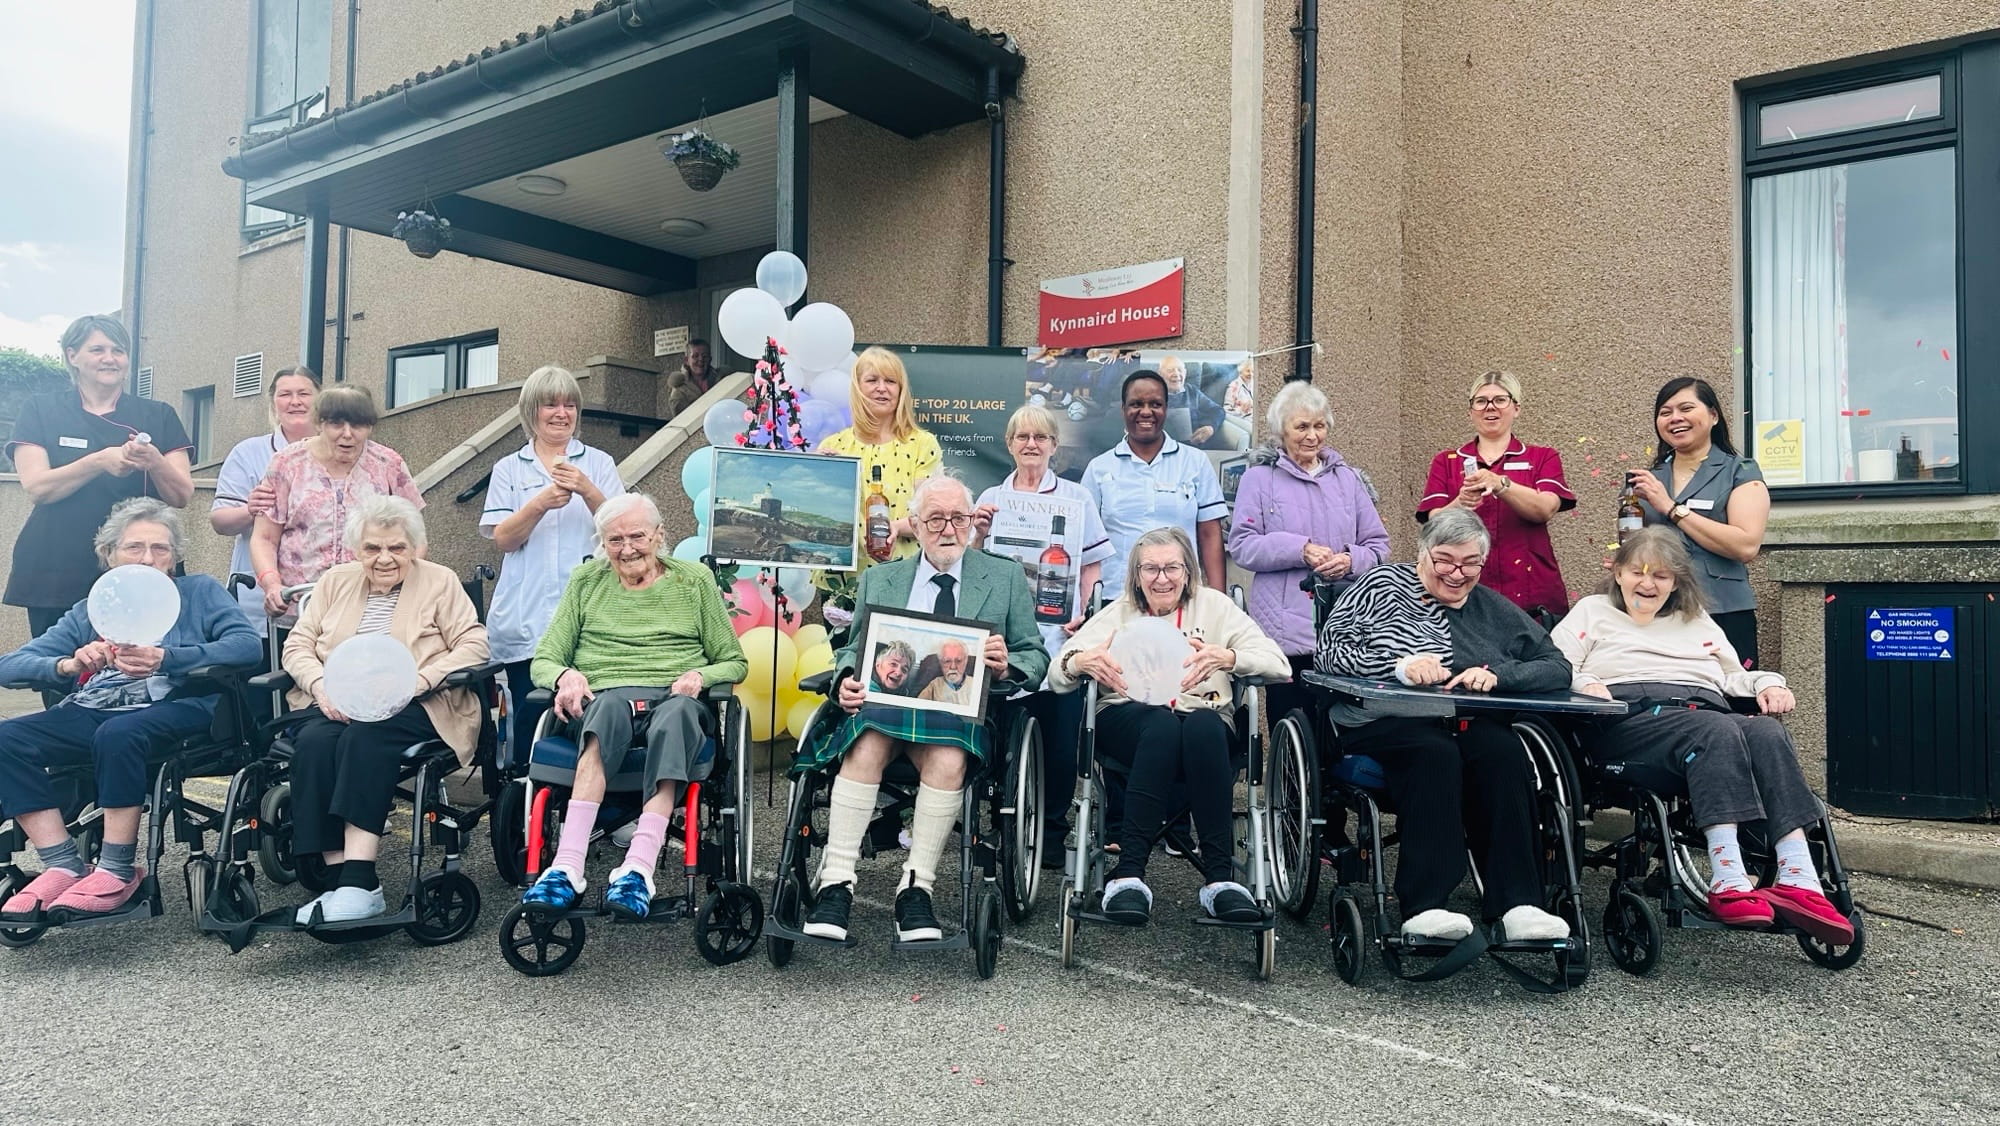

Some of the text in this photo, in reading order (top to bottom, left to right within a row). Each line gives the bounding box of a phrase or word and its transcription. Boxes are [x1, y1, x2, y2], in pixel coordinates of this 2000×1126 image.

[1049, 305, 1170, 335] Kynnaird House
[952, 399, 967, 409] 20
[970, 400, 1006, 410] LARGE
[918, 413, 974, 424] IN THE UK.
[940, 434, 971, 442] reviews
[973, 433, 994, 442] from
[1765, 446, 1796, 455] CCTV
[1007, 499, 1071, 516] WINNER!
